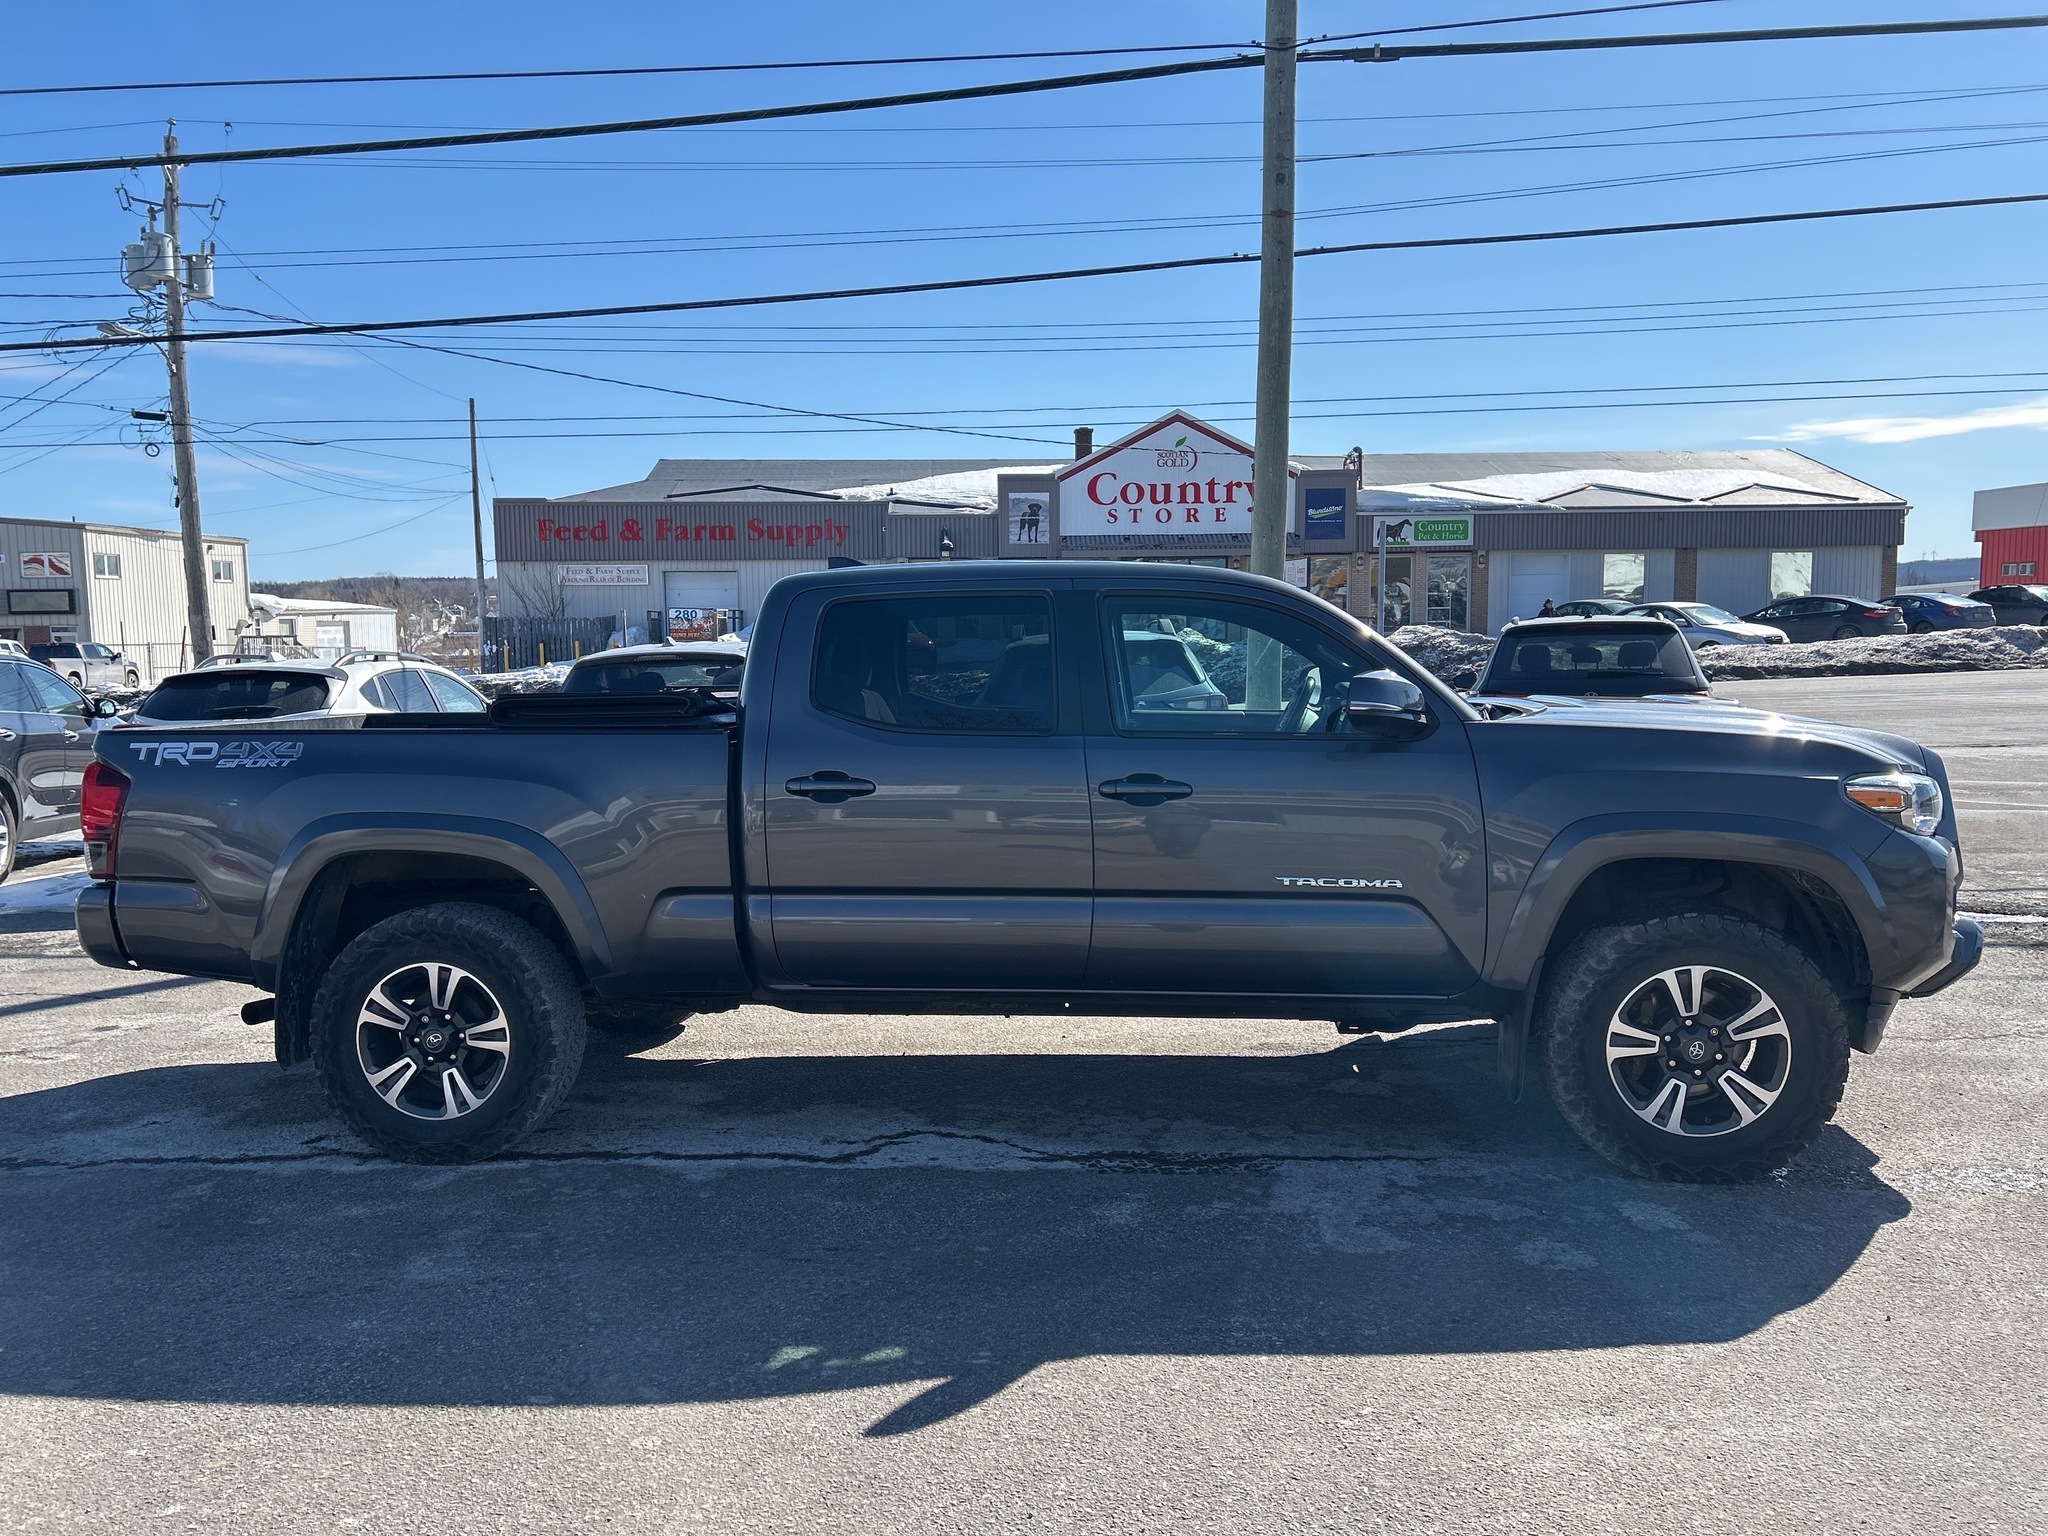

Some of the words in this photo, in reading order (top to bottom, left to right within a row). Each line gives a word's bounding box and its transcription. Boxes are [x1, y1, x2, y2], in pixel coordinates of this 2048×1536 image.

[1156, 458, 1189, 468] GOLD
[1107, 507, 1227, 524] STORE
[537, 517, 609, 542] Feed
[619, 517, 644, 542] &
[656, 517, 736, 542] Farm
[747, 516, 850, 547] Supply
[1418, 521, 1465, 533] Country
[1441, 532, 1465, 540] Horse
[566, 567, 584, 575] FEED
[585, 567, 593, 575] &
[595, 567, 613, 575] FARM
[616, 567, 640, 575] SUPPLY
[674, 609, 698, 620] 280
[129, 741, 219, 767] TRD
[220, 741, 305, 759] 4X4
[215, 758, 297, 768] SPORT
[1275, 876, 1403, 889] TACOMA
